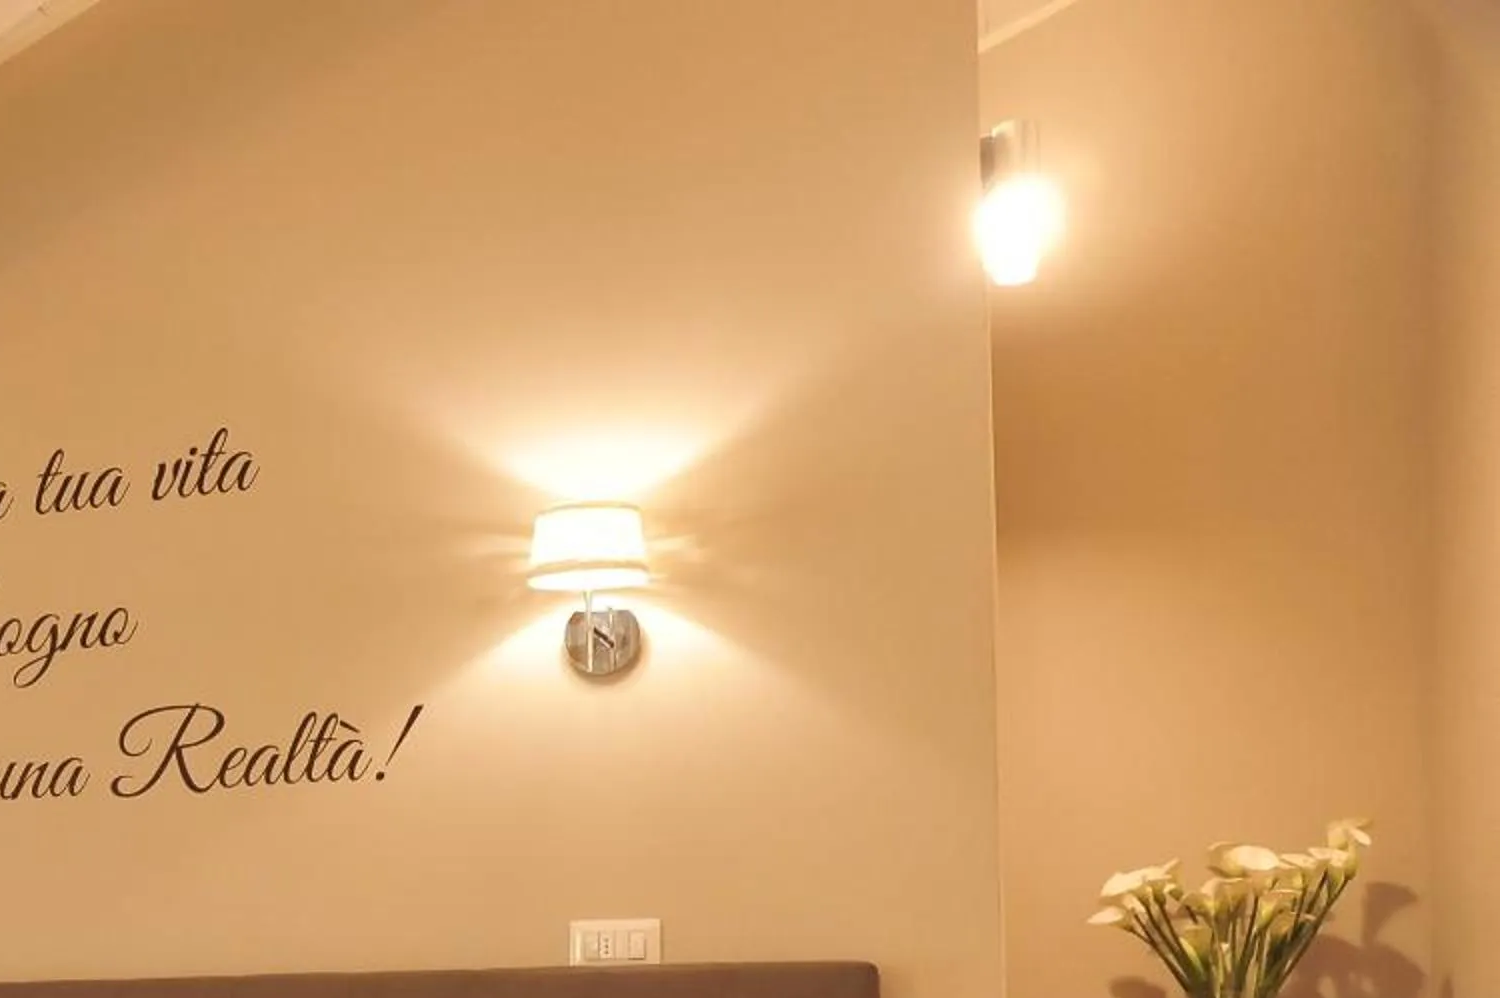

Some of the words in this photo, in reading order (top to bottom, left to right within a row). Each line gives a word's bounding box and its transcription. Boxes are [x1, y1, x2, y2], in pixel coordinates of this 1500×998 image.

[34, 447, 131, 516] tua
[151, 427, 261, 502] vita
[109, 702, 426, 799] Realtà!
